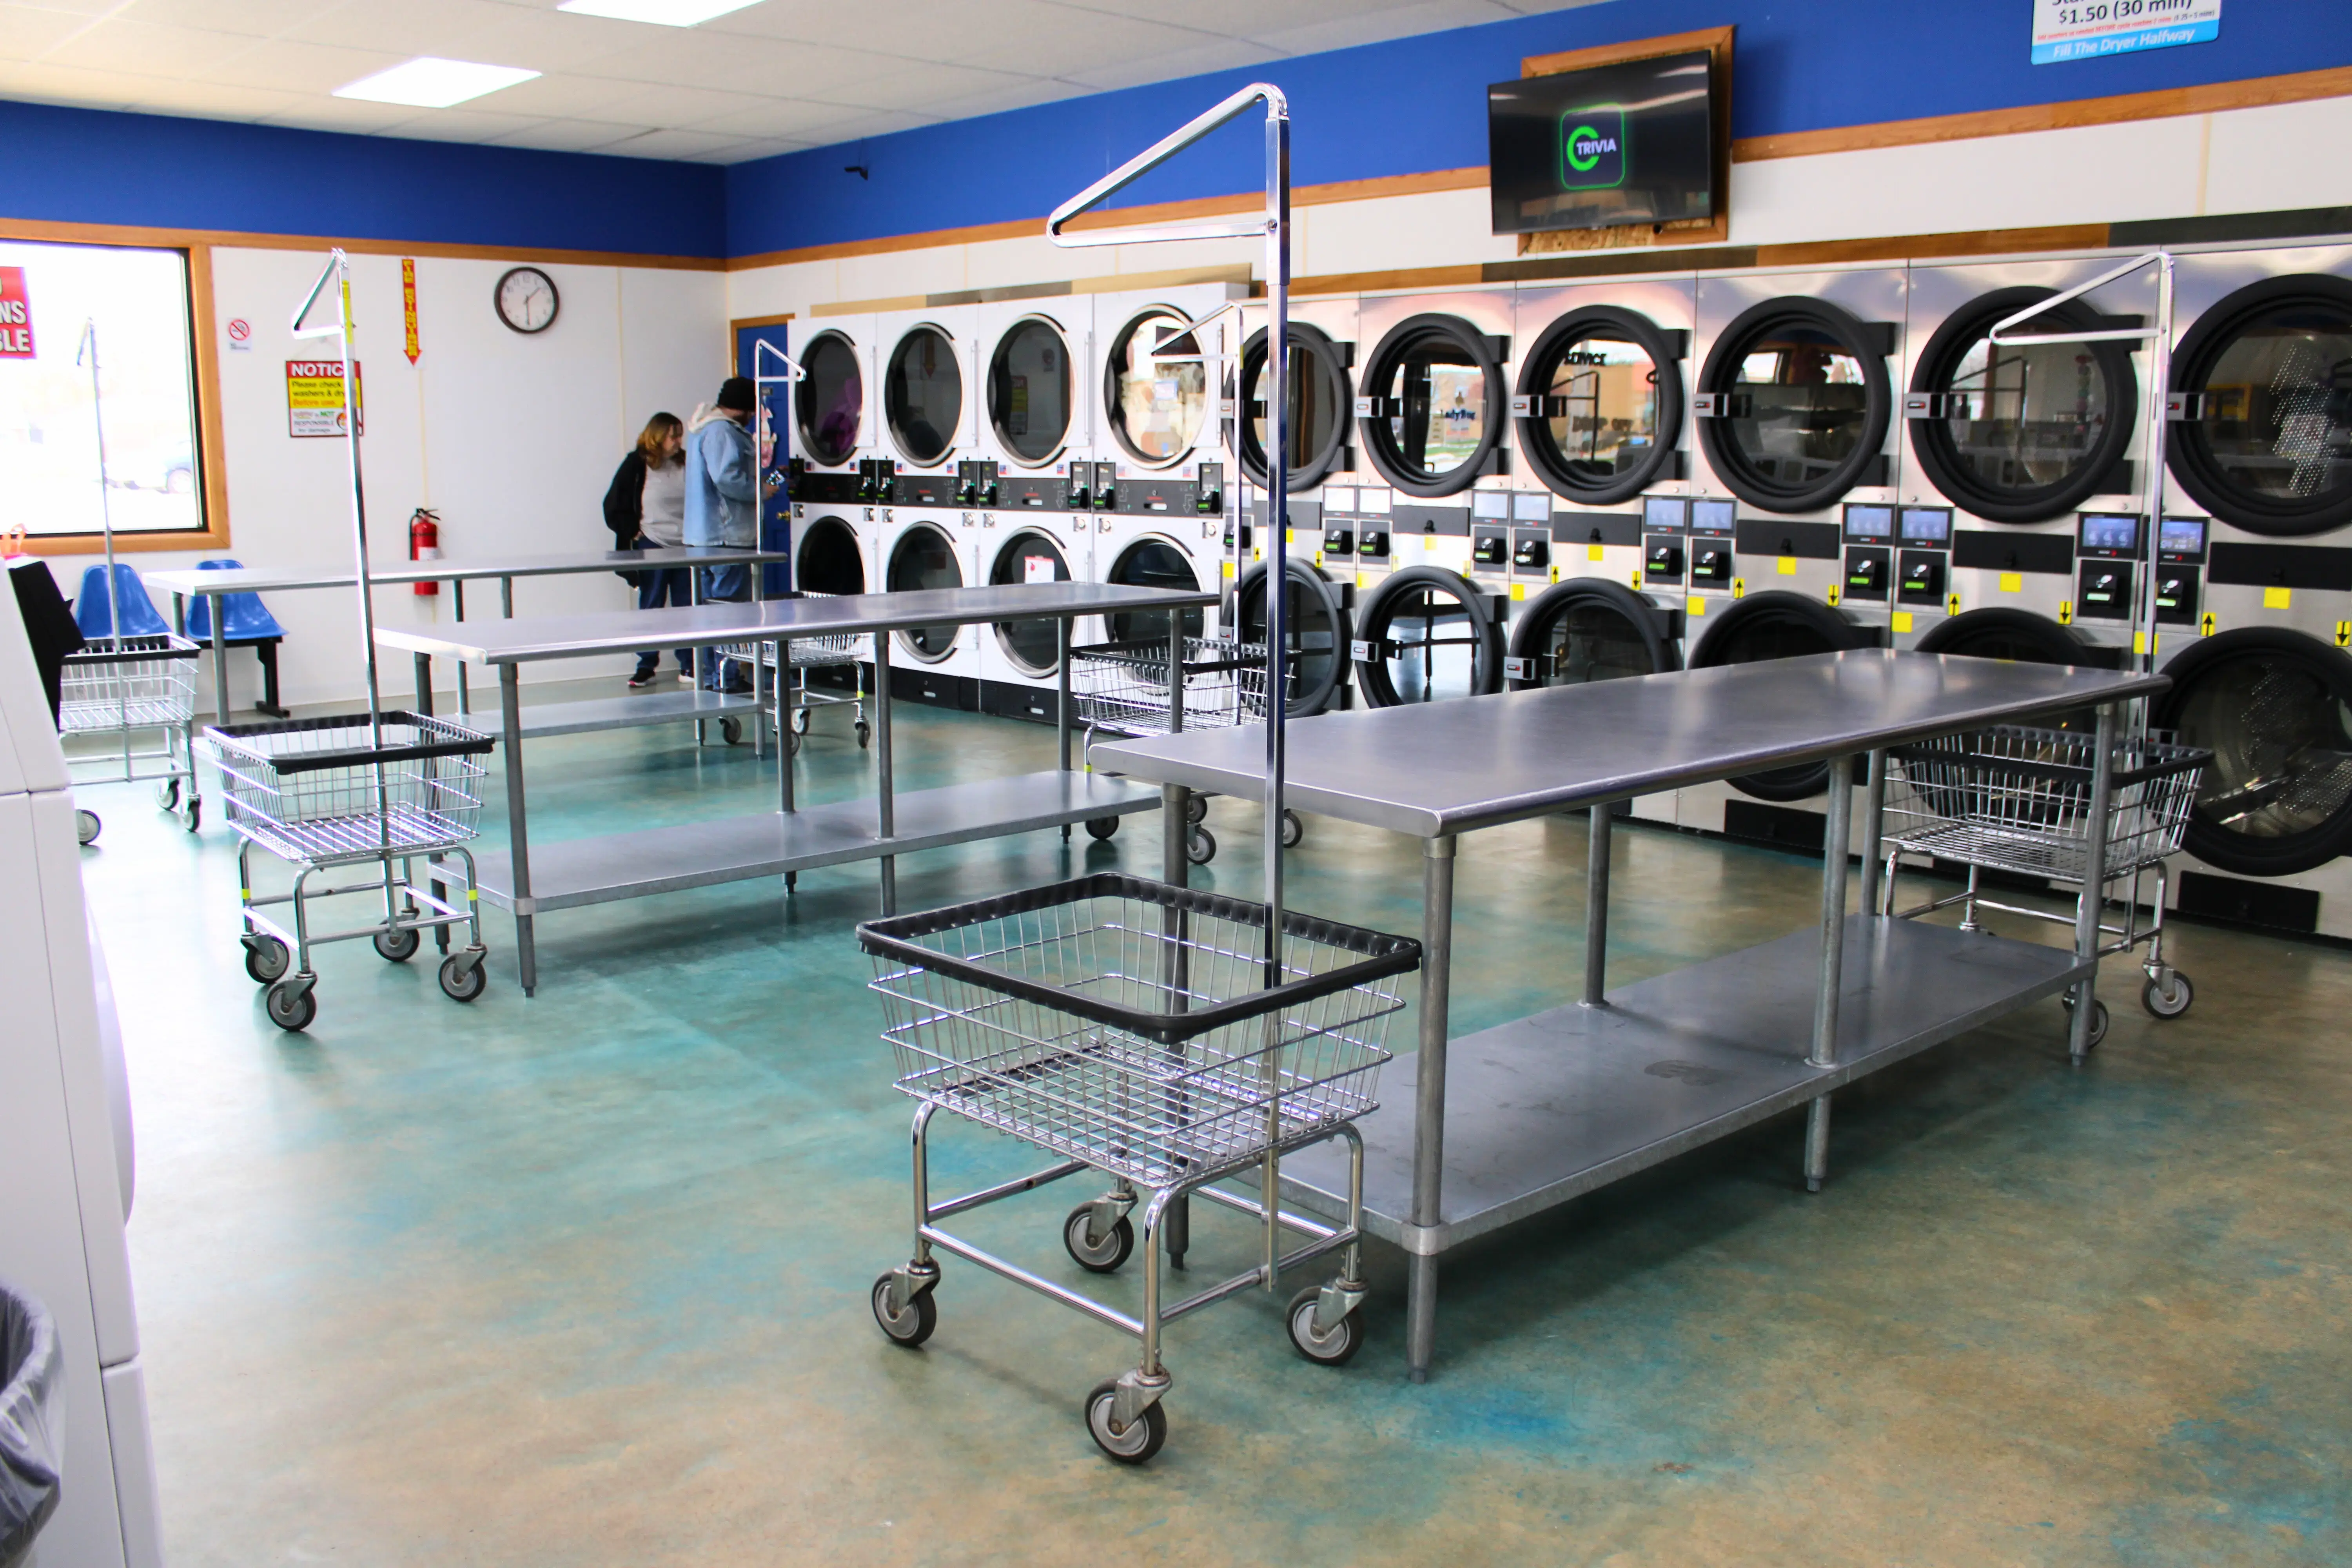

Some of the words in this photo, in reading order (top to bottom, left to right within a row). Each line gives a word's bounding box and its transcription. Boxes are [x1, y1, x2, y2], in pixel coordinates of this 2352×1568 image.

[2059, 5, 2107, 25] $1.50
[2114, 1, 2142, 20] (30
[2053, 45, 2071, 58] Fill
[2074, 42, 2097, 55] The
[2100, 34, 2137, 54] Dryer
[2140, 28, 2196, 45] Halfway
[1576, 138, 1617, 156] TRIVIA
[292, 363, 344, 377] NOTIC
